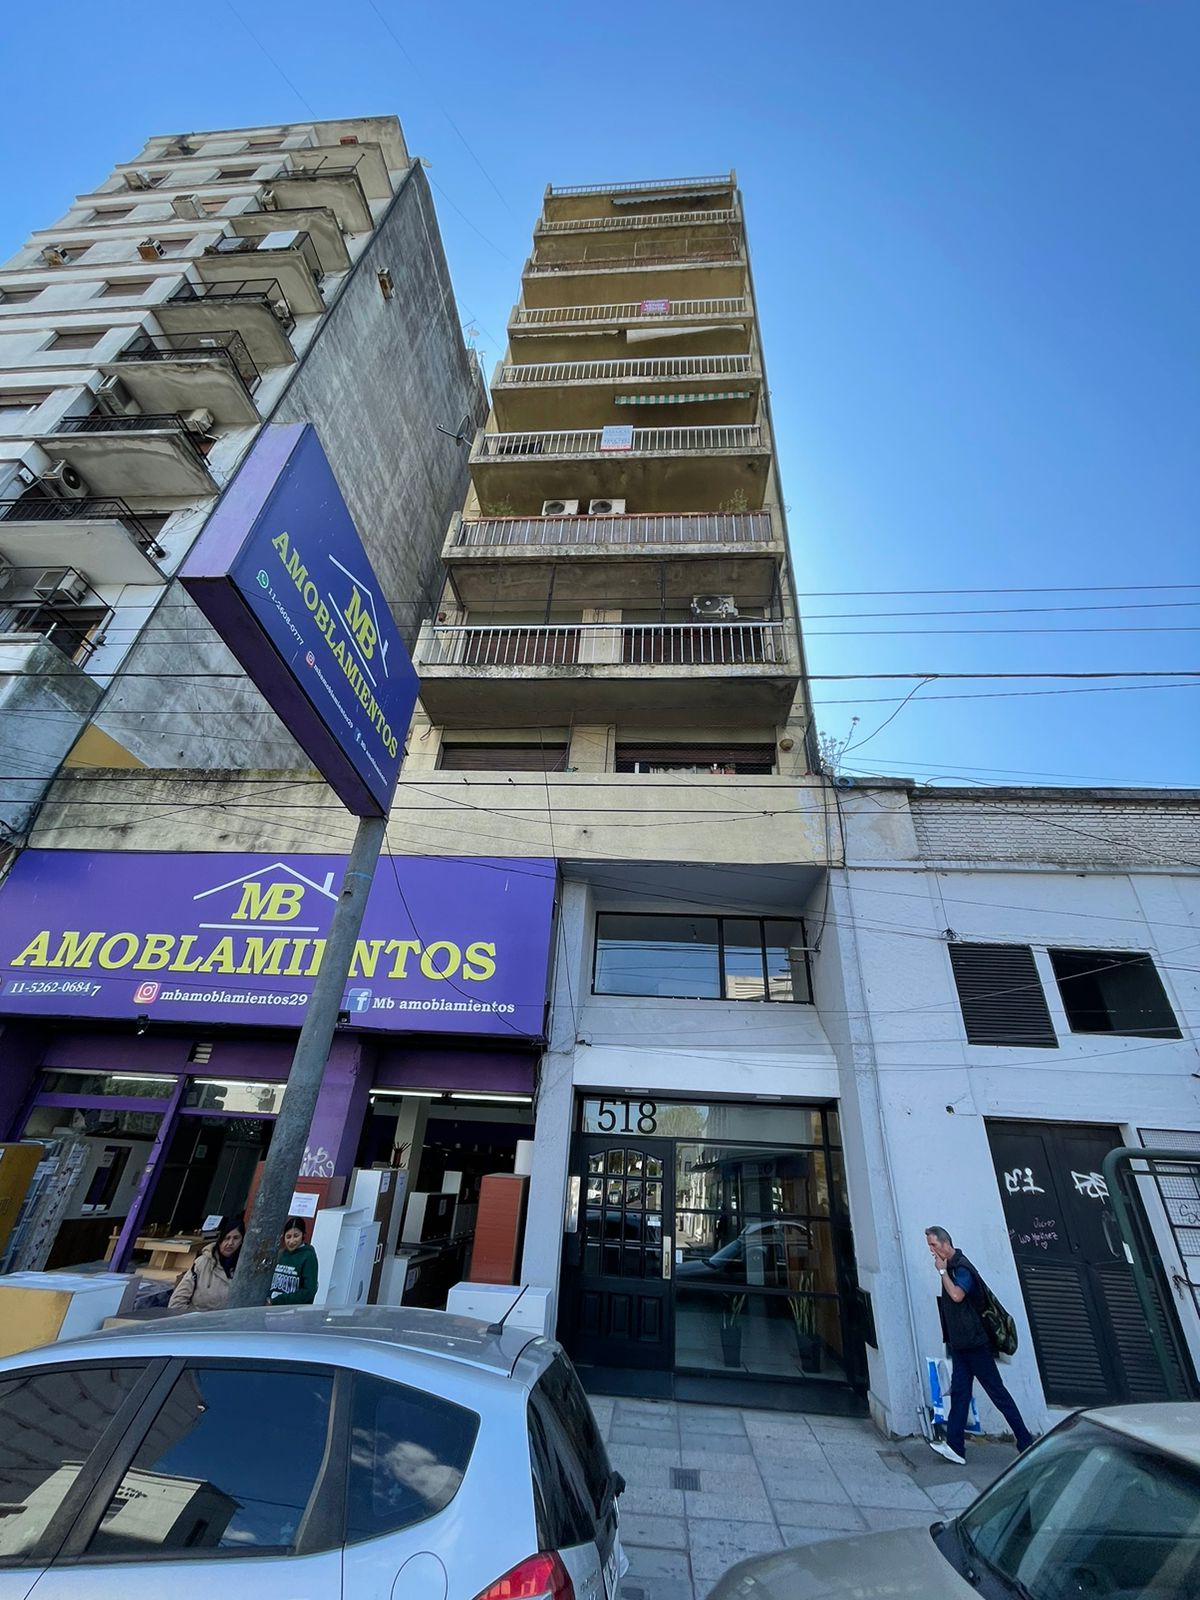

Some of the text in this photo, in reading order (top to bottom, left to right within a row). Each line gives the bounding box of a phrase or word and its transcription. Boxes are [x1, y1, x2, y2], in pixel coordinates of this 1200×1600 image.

[268, 587, 304, 646] 11-2608-0777
[344, 585, 377, 660] MB
[272, 531, 398, 758] AMOBLAMIENTOS
[231, 882, 305, 922] MB
[160, 990, 308, 1006] mbamoblamientos29
[372, 998, 515, 1013] Mb amoblamientos
[597, 1099, 657, 1134] 518
